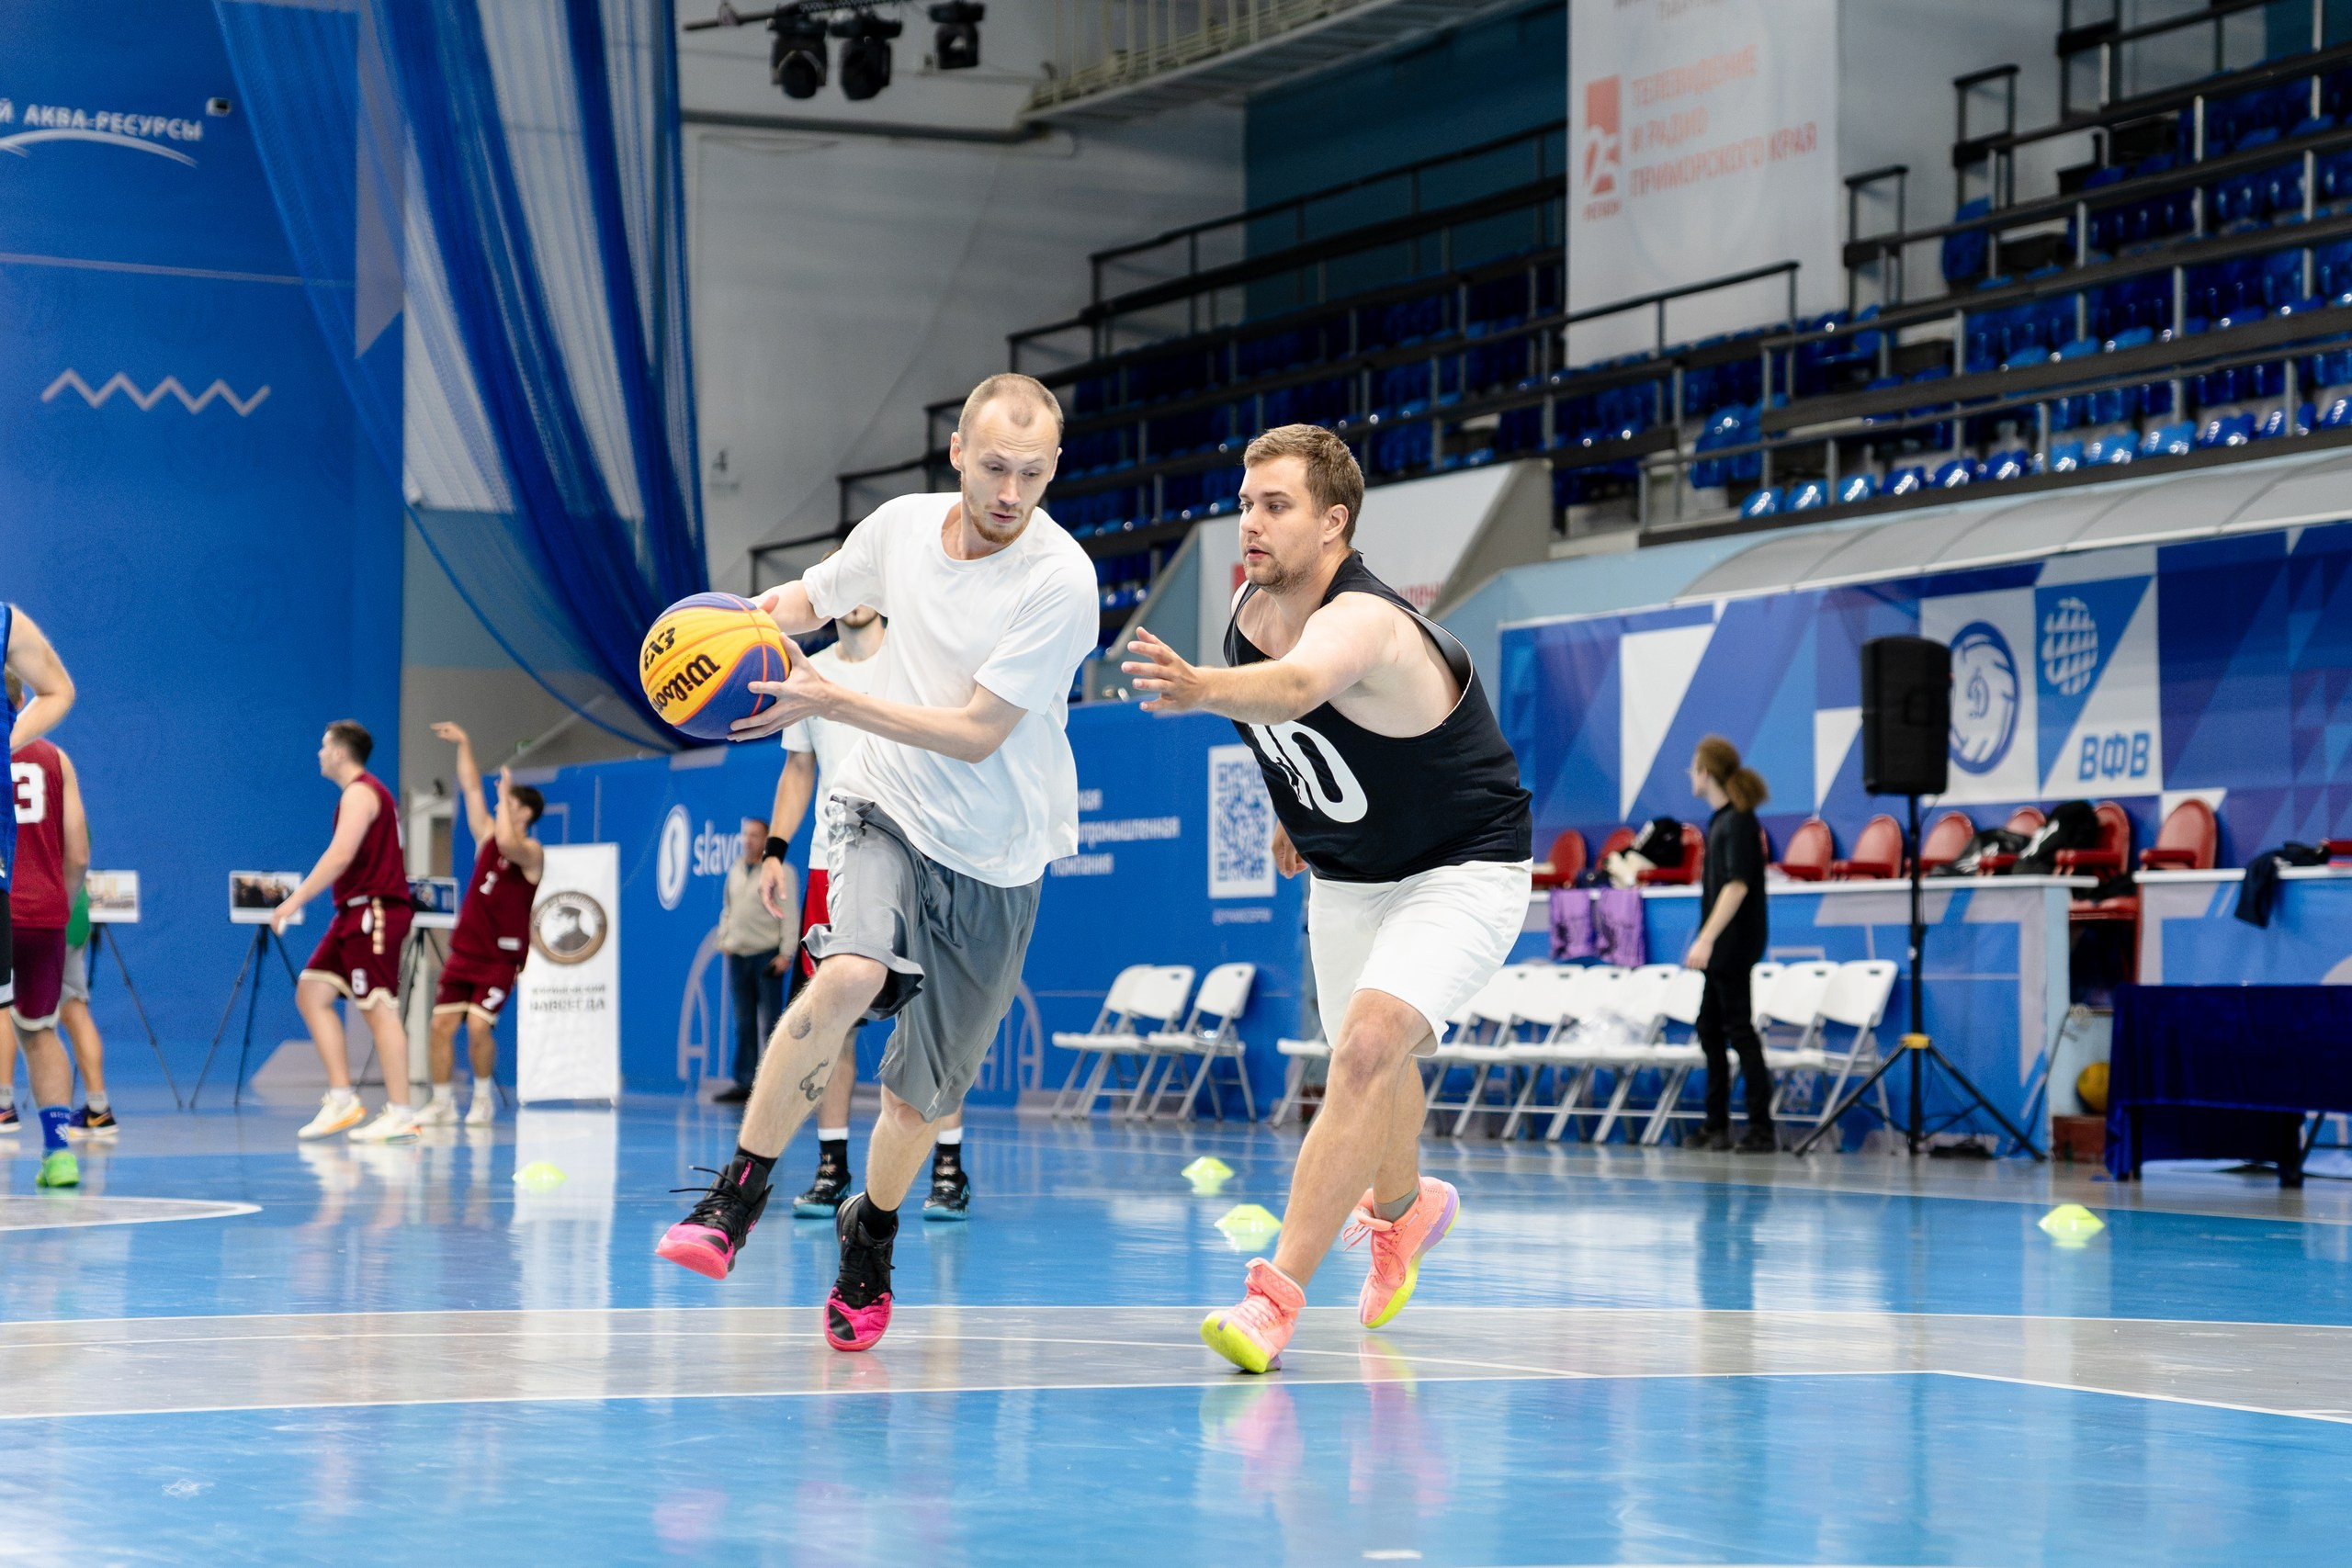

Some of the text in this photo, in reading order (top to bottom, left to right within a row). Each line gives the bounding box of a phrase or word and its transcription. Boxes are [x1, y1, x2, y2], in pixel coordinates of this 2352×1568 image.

[23, 103, 204, 141] АКВА-РЕСУРСЫ
[1647, 106, 1708, 147] РАДИО
[1629, 120, 1816, 197] ПРИМОРСКОГО КРАЯ
[651, 653, 721, 713] Wilson
[2077, 731, 2151, 781] ВФВ
[481, 987, 504, 1010] 7
